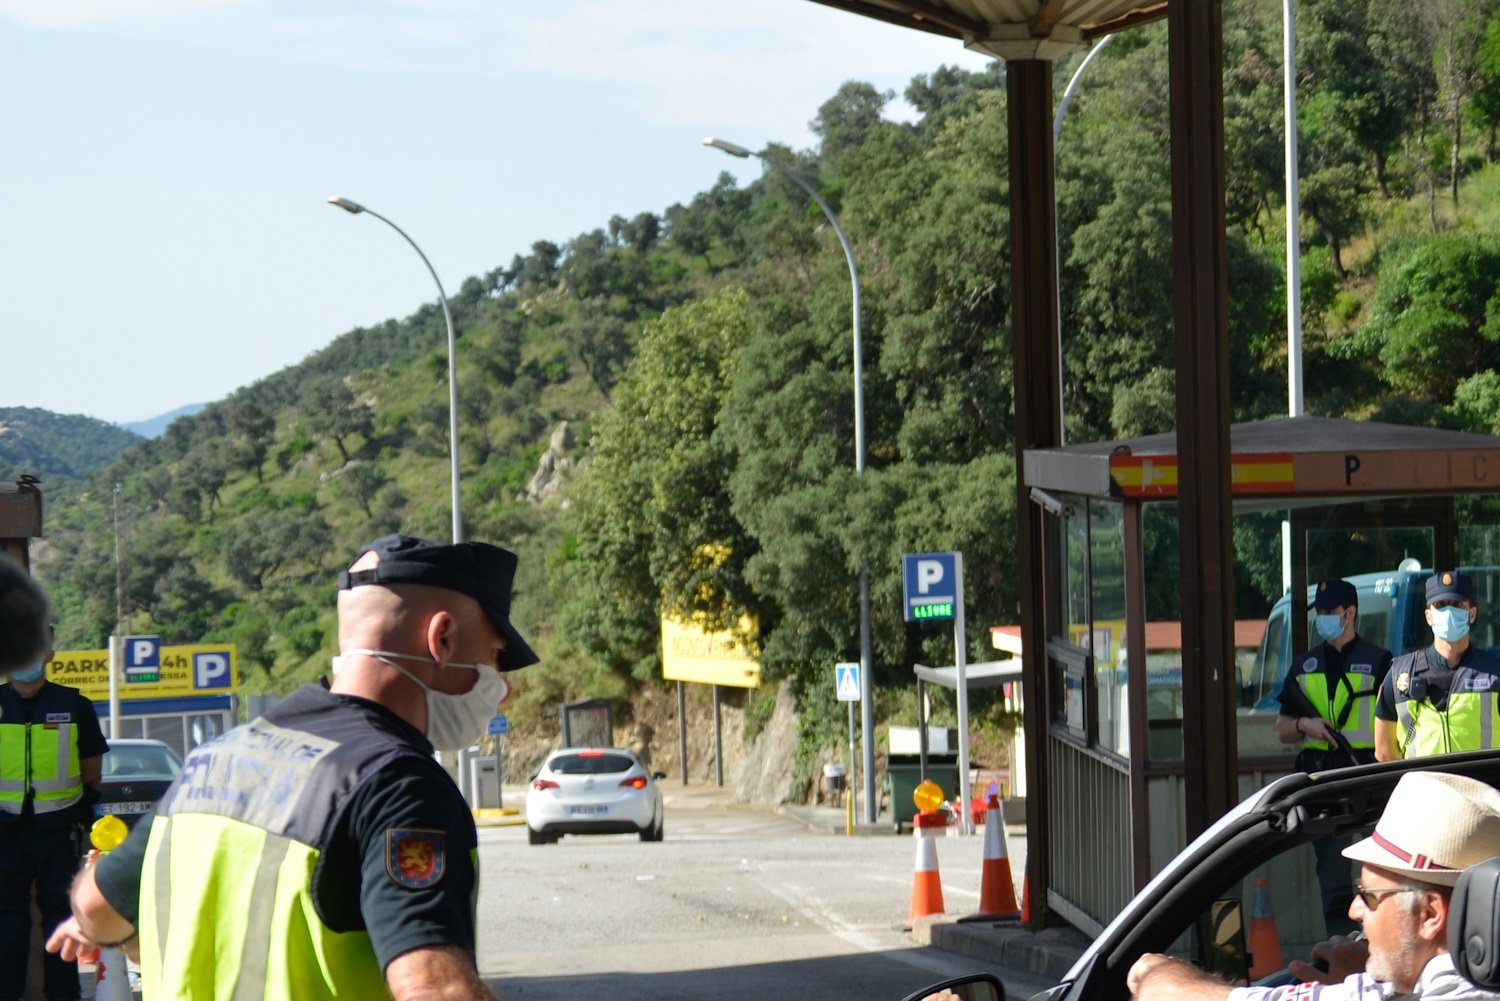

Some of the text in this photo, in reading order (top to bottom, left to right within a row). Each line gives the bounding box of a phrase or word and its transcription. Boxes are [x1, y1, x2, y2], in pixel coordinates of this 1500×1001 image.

[917, 560, 944, 594] P
[133, 640, 154, 665] P
[196, 653, 227, 687] P
